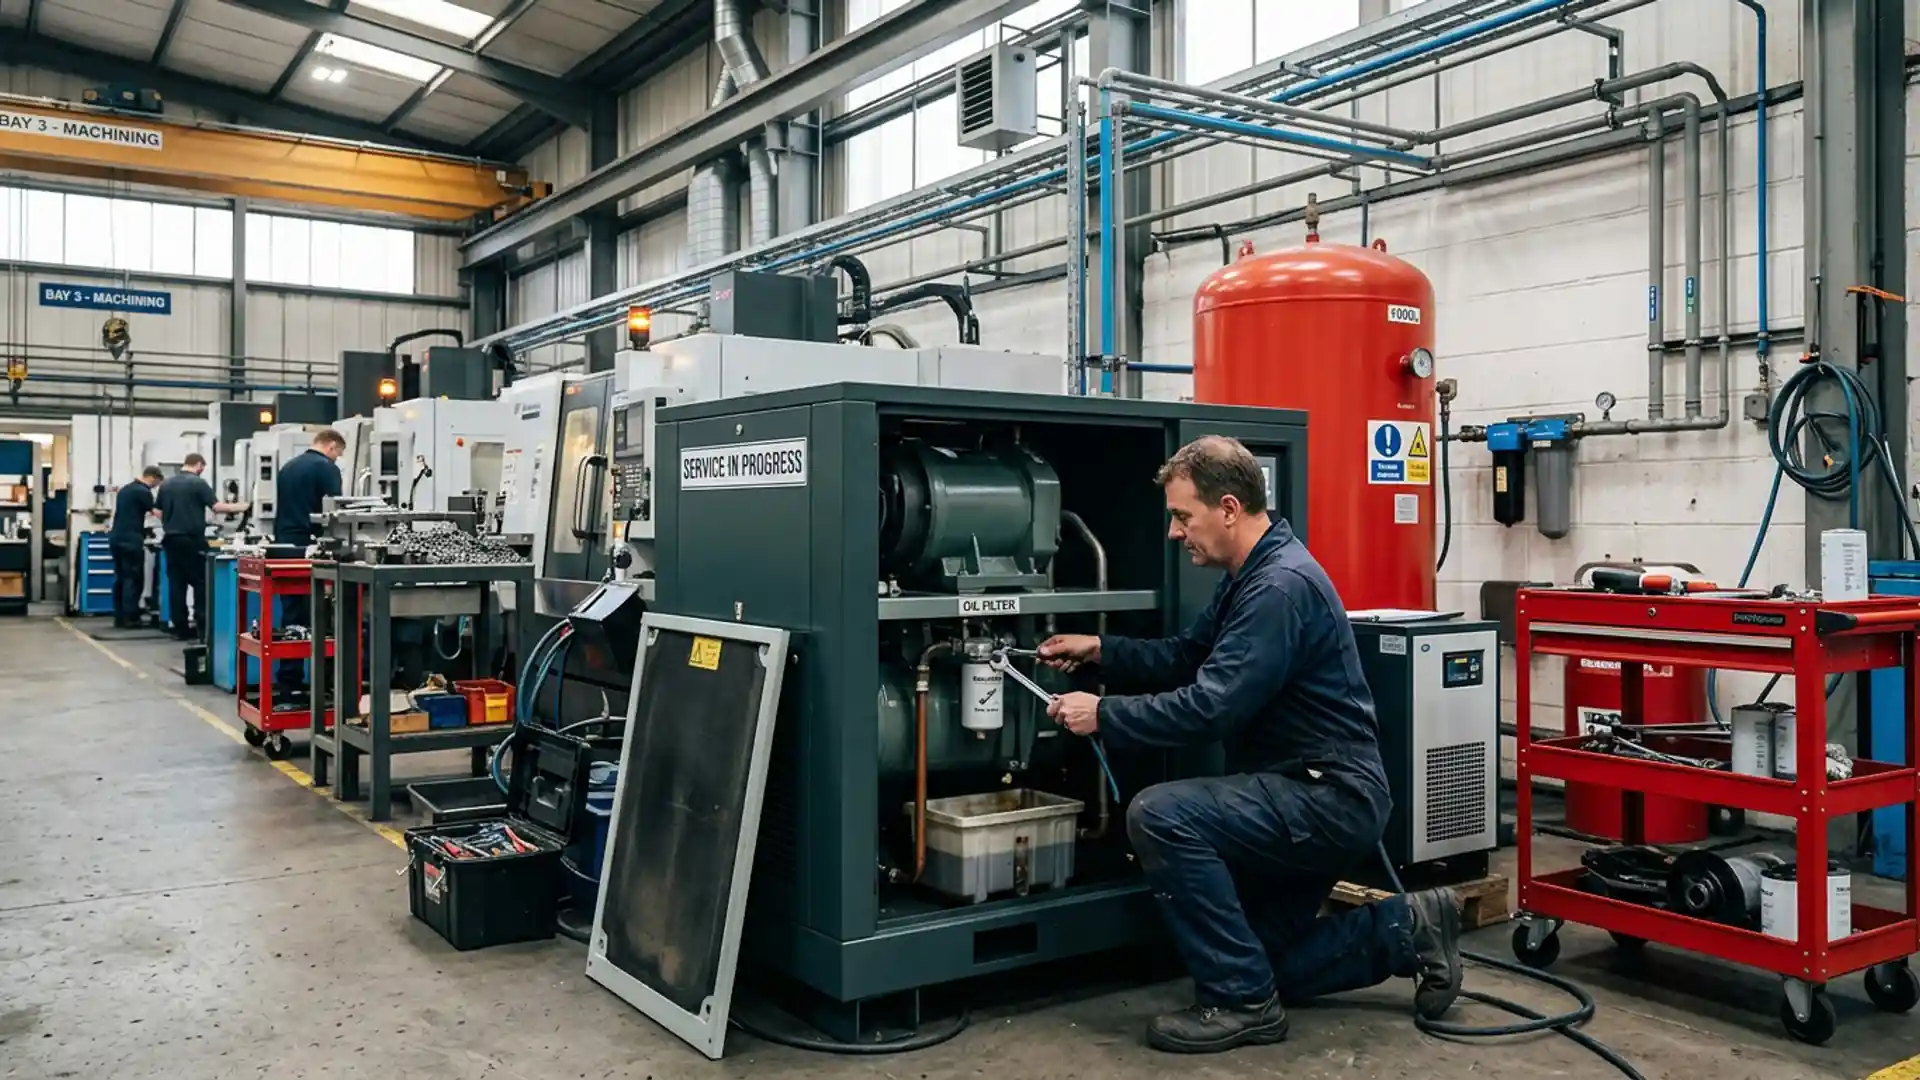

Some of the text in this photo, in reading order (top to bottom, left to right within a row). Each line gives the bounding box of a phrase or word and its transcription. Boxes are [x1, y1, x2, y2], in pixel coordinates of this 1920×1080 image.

[0, 115, 32, 129] BAY
[38, 120, 47, 131] 3
[63, 122, 160, 146] MACHINING
[45, 289, 71, 301] BAY
[74, 291, 82, 302] 3
[93, 292, 165, 308] MACHINING
[683, 449, 802, 479] SERVICE IN PROGRESS
[963, 600, 980, 611] OIL
